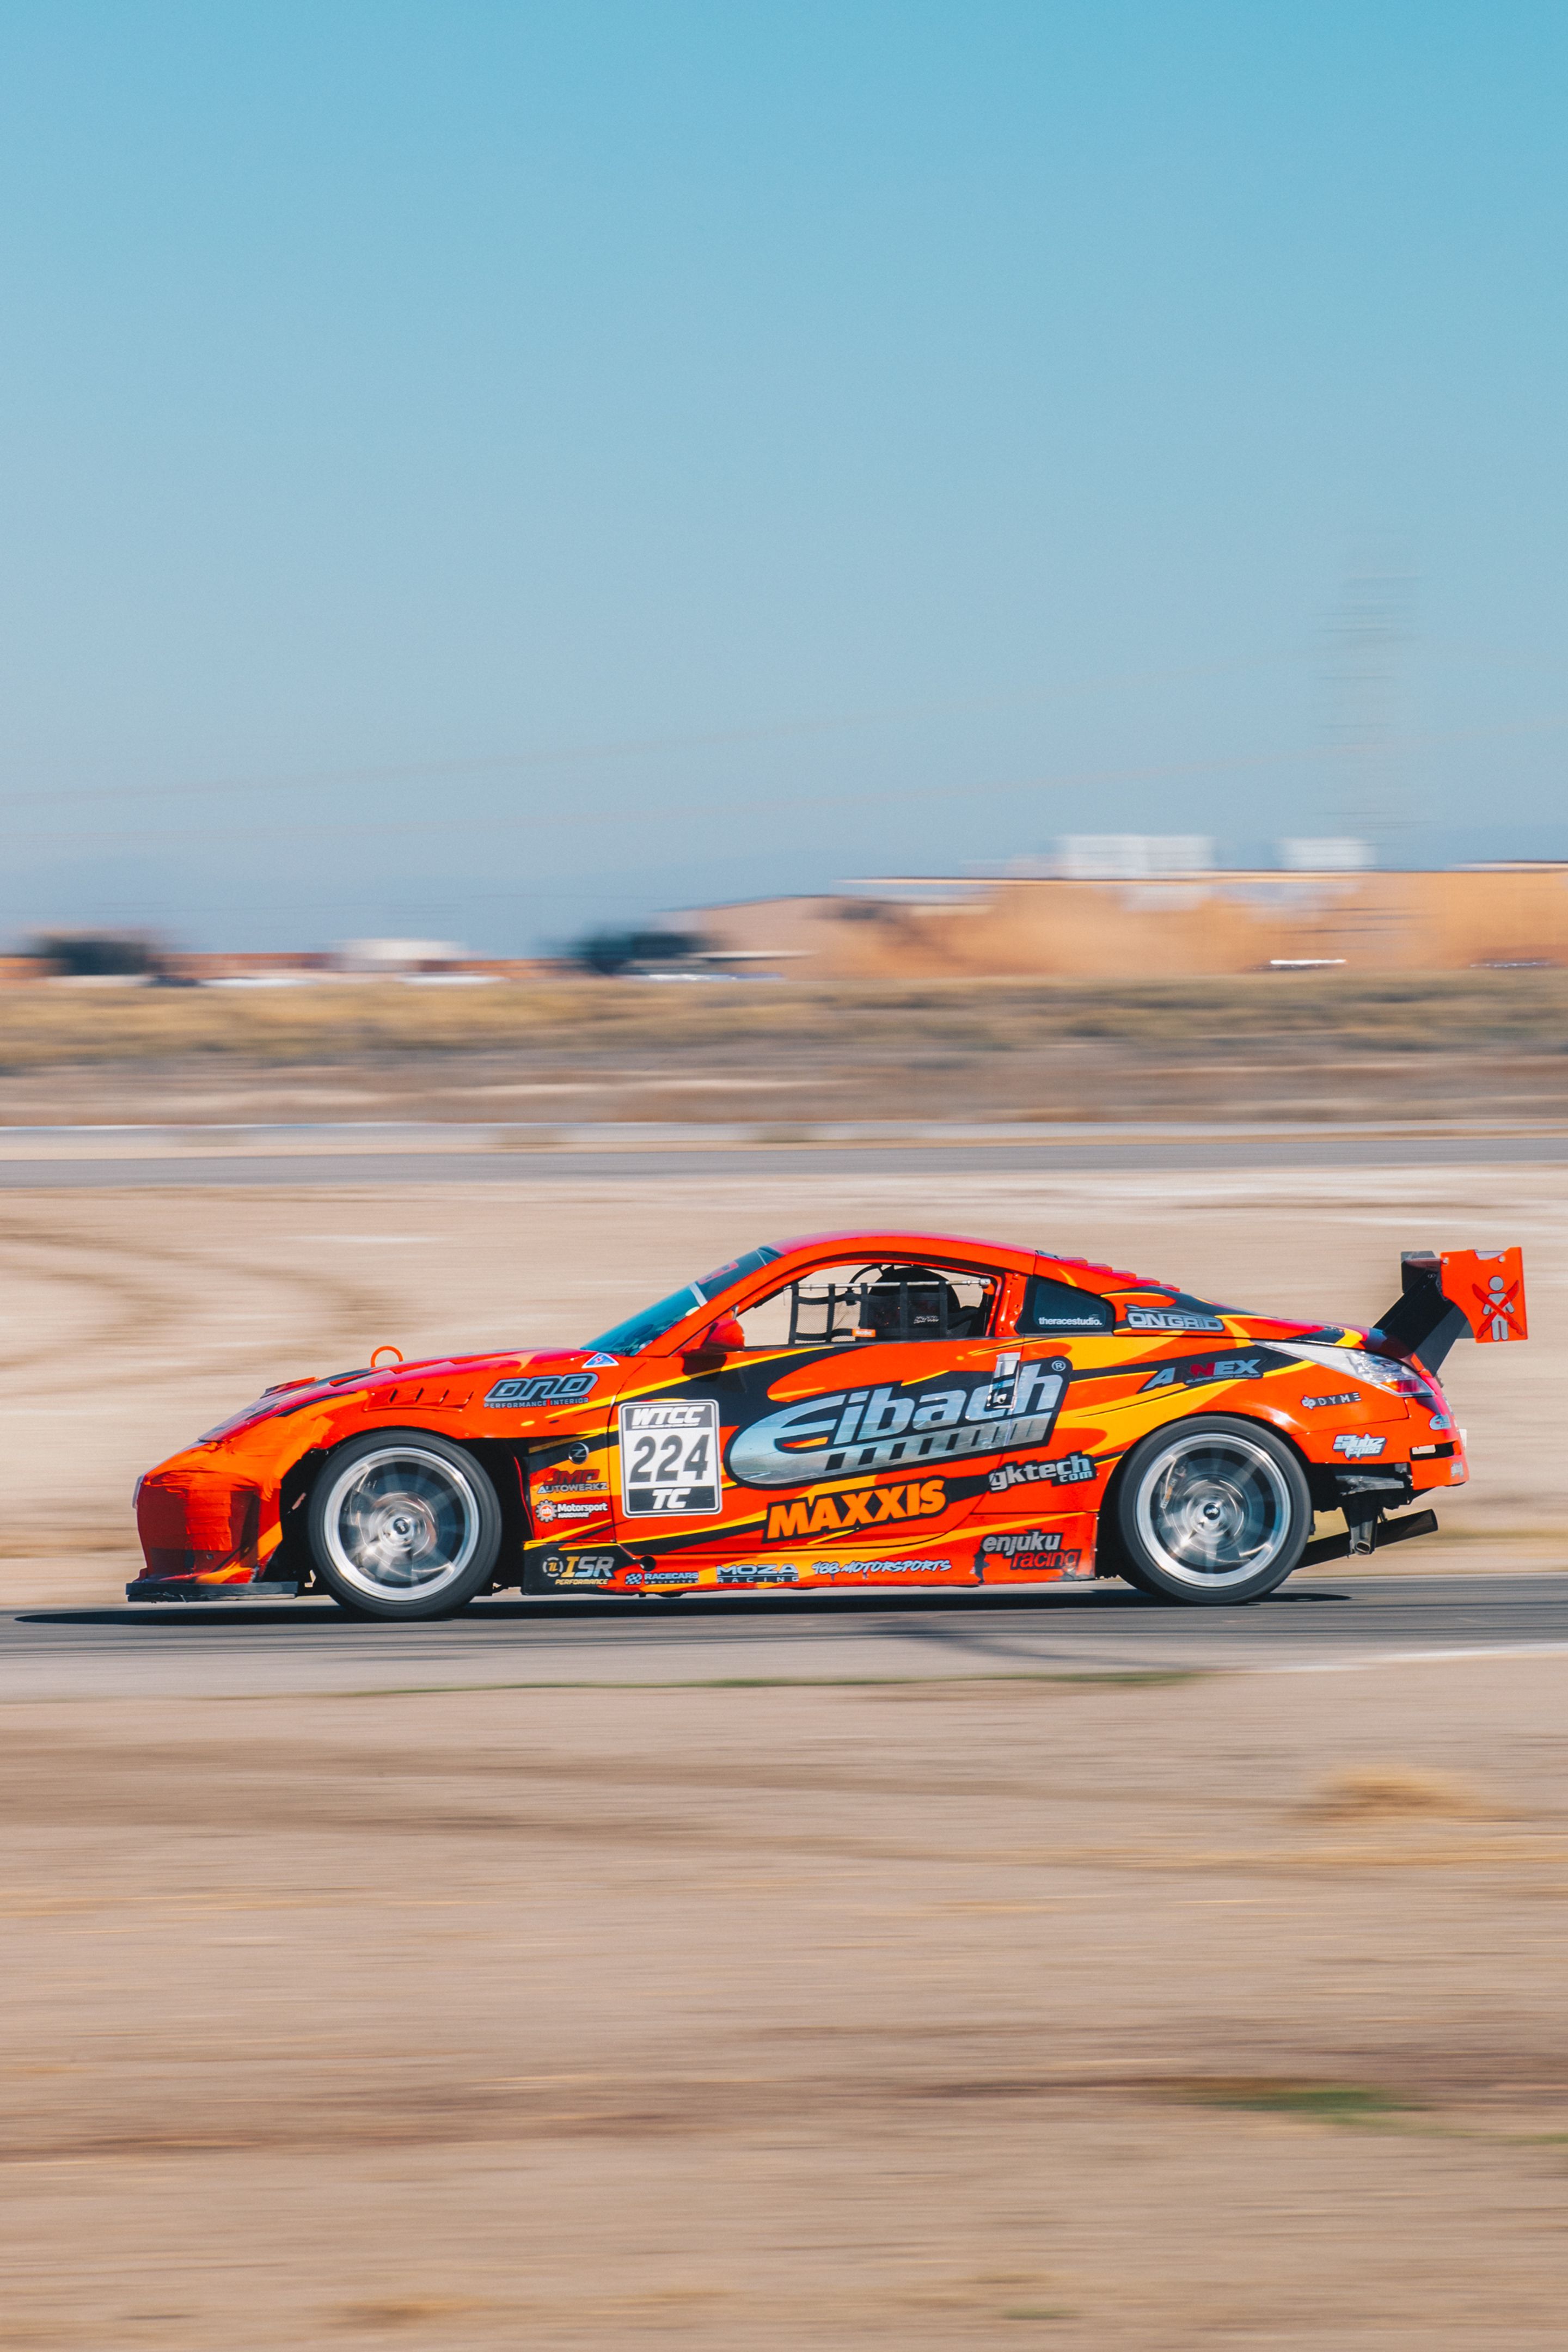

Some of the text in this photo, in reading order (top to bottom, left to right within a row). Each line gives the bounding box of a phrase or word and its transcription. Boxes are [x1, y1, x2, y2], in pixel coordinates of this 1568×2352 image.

[1143, 1359, 1261, 1391] ANEX
[483, 1397, 589, 1409] PERFORMANCE INTERIOR
[632, 1406, 706, 1425] WTCC
[730, 1363, 1066, 1484] Eibach
[628, 1434, 710, 1483] 224
[543, 1468, 601, 1486] JMP
[988, 1455, 1091, 1491] gktech
[1059, 1471, 1093, 1483] com
[537, 1482, 609, 1494] AUTOWERKZ
[652, 1487, 692, 1509] TC
[557, 1503, 609, 1514] Motorsport
[767, 1479, 947, 1540] MAXXIS
[982, 1531, 1061, 1556] enjuku
[560, 1555, 615, 1578] ISR
[716, 1564, 799, 1575] MOZA
[840, 1560, 952, 1574] MOTORSPORTS
[1012, 1551, 1079, 1572] racing
[644, 1571, 699, 1580] RACECARS
